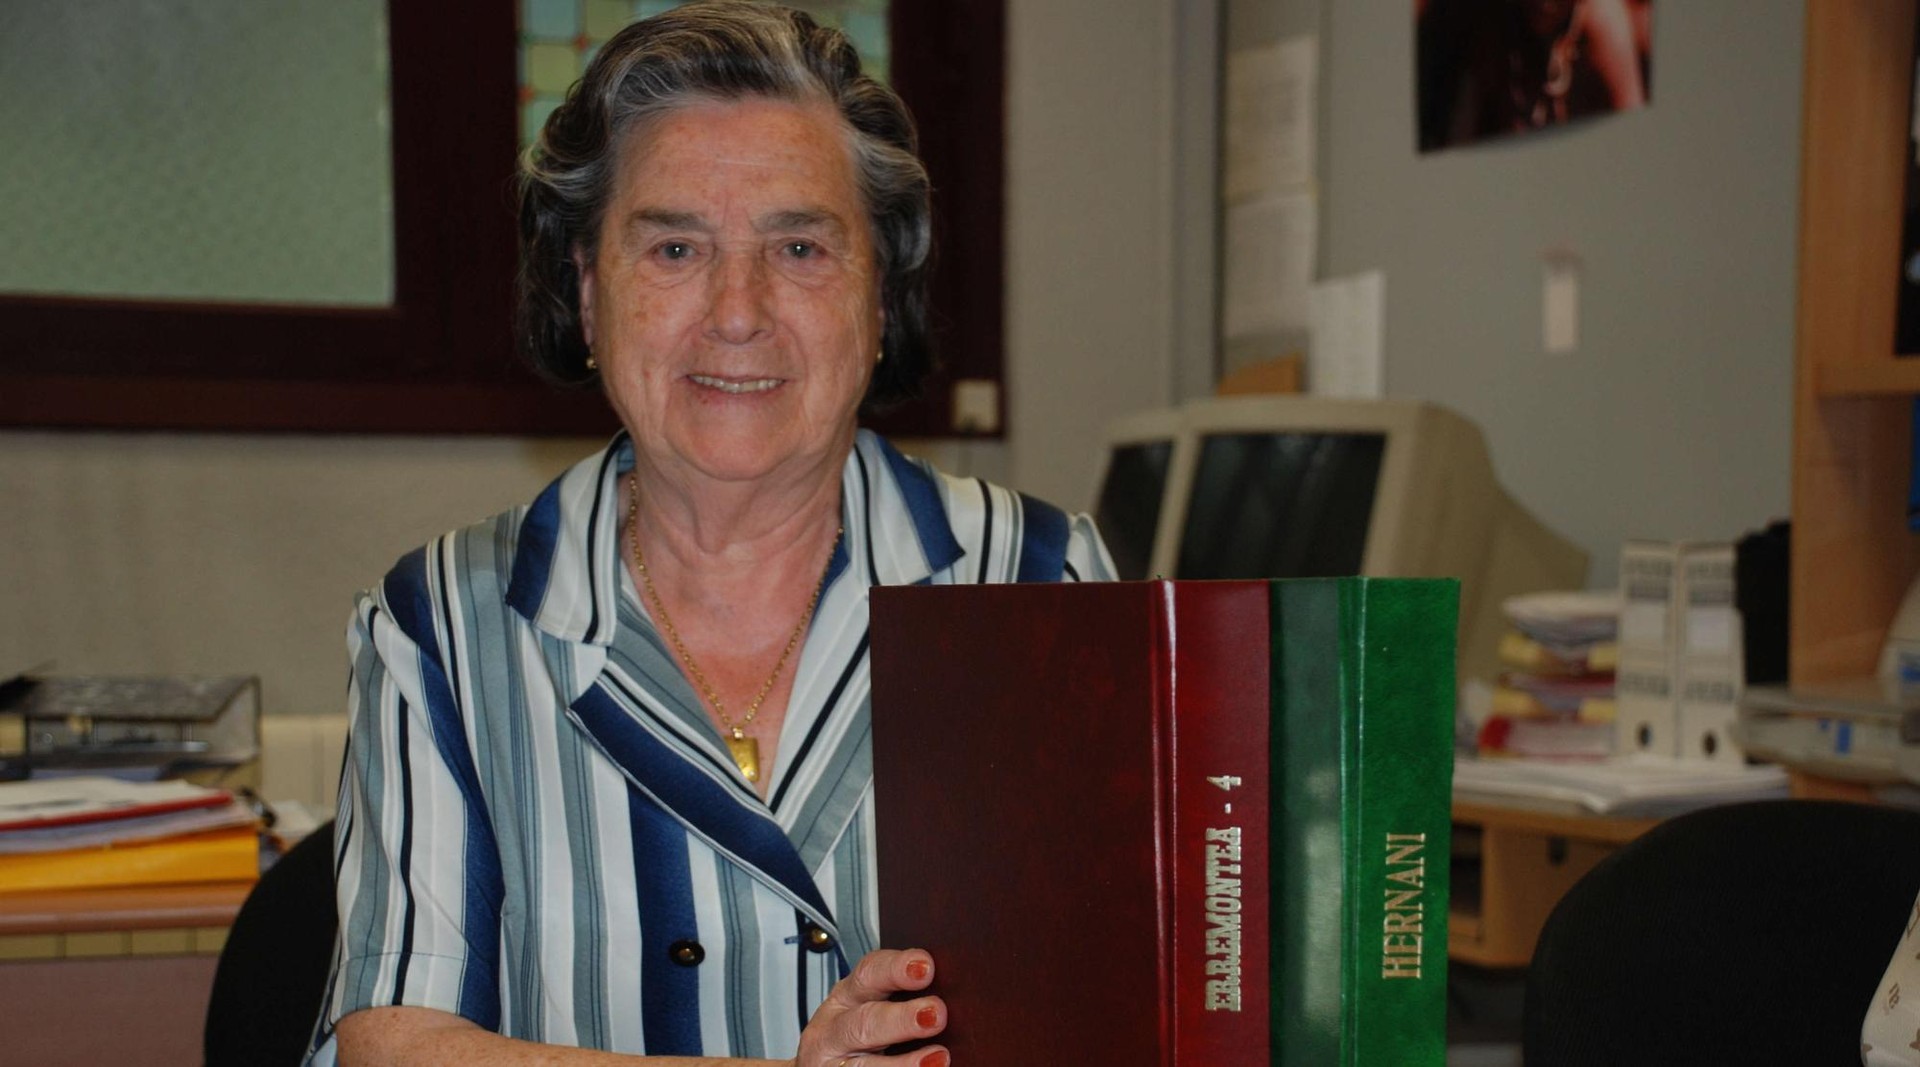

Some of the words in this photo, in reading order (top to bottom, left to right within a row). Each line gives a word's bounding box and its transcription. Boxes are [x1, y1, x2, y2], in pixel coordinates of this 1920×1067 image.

[1206, 775, 1242, 791] 4
[1205, 826, 1241, 1012] ERREMONTEA
[1382, 833, 1426, 980] HERNANI
